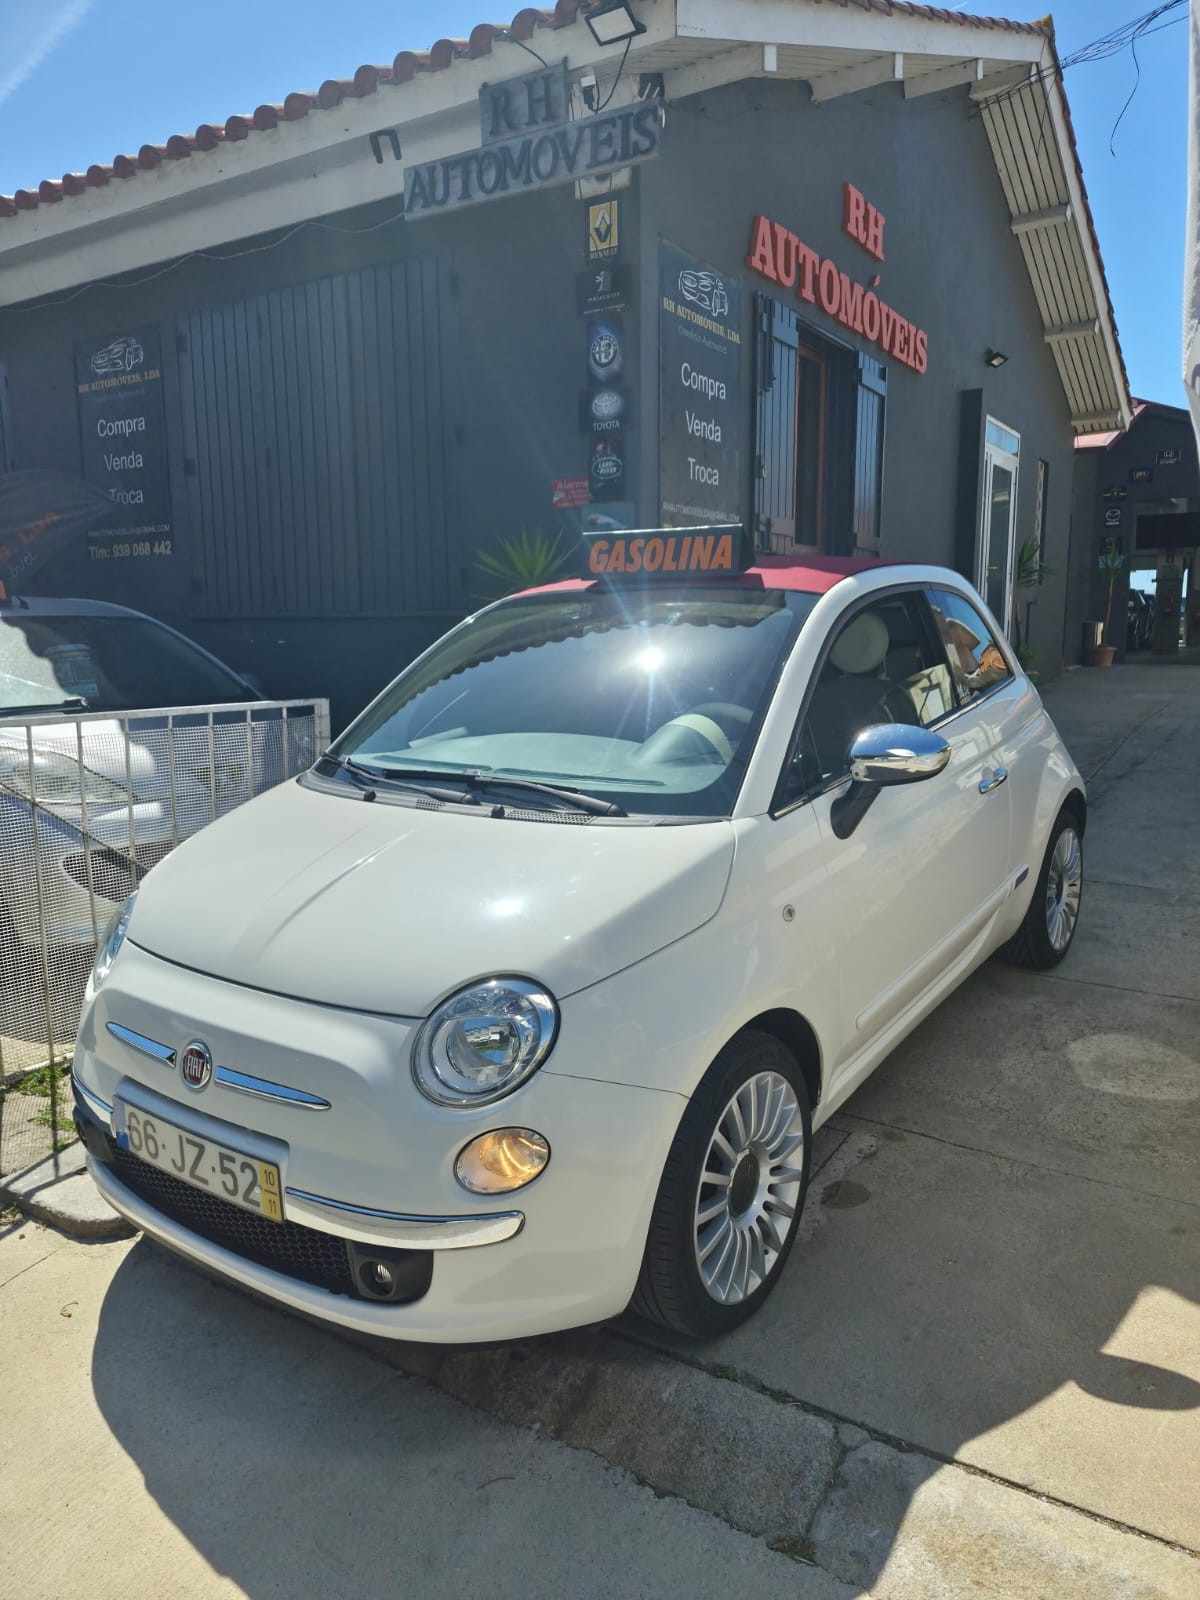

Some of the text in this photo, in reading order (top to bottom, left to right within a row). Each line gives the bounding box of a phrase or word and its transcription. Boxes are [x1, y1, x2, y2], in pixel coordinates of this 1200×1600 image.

[489, 74, 560, 137] RH
[844, 181, 886, 261] RH
[749, 215, 928, 375] AUTOMÓVEIS
[681, 362, 726, 401] Compra
[97, 415, 146, 438] Compra
[685, 408, 721, 442] Venda
[104, 452, 143, 473] Venda
[688, 457, 719, 486] Troca
[589, 534, 733, 574] GASOLINA
[185, 1055, 206, 1079] FIAT
[263, 1167, 275, 1186] 10
